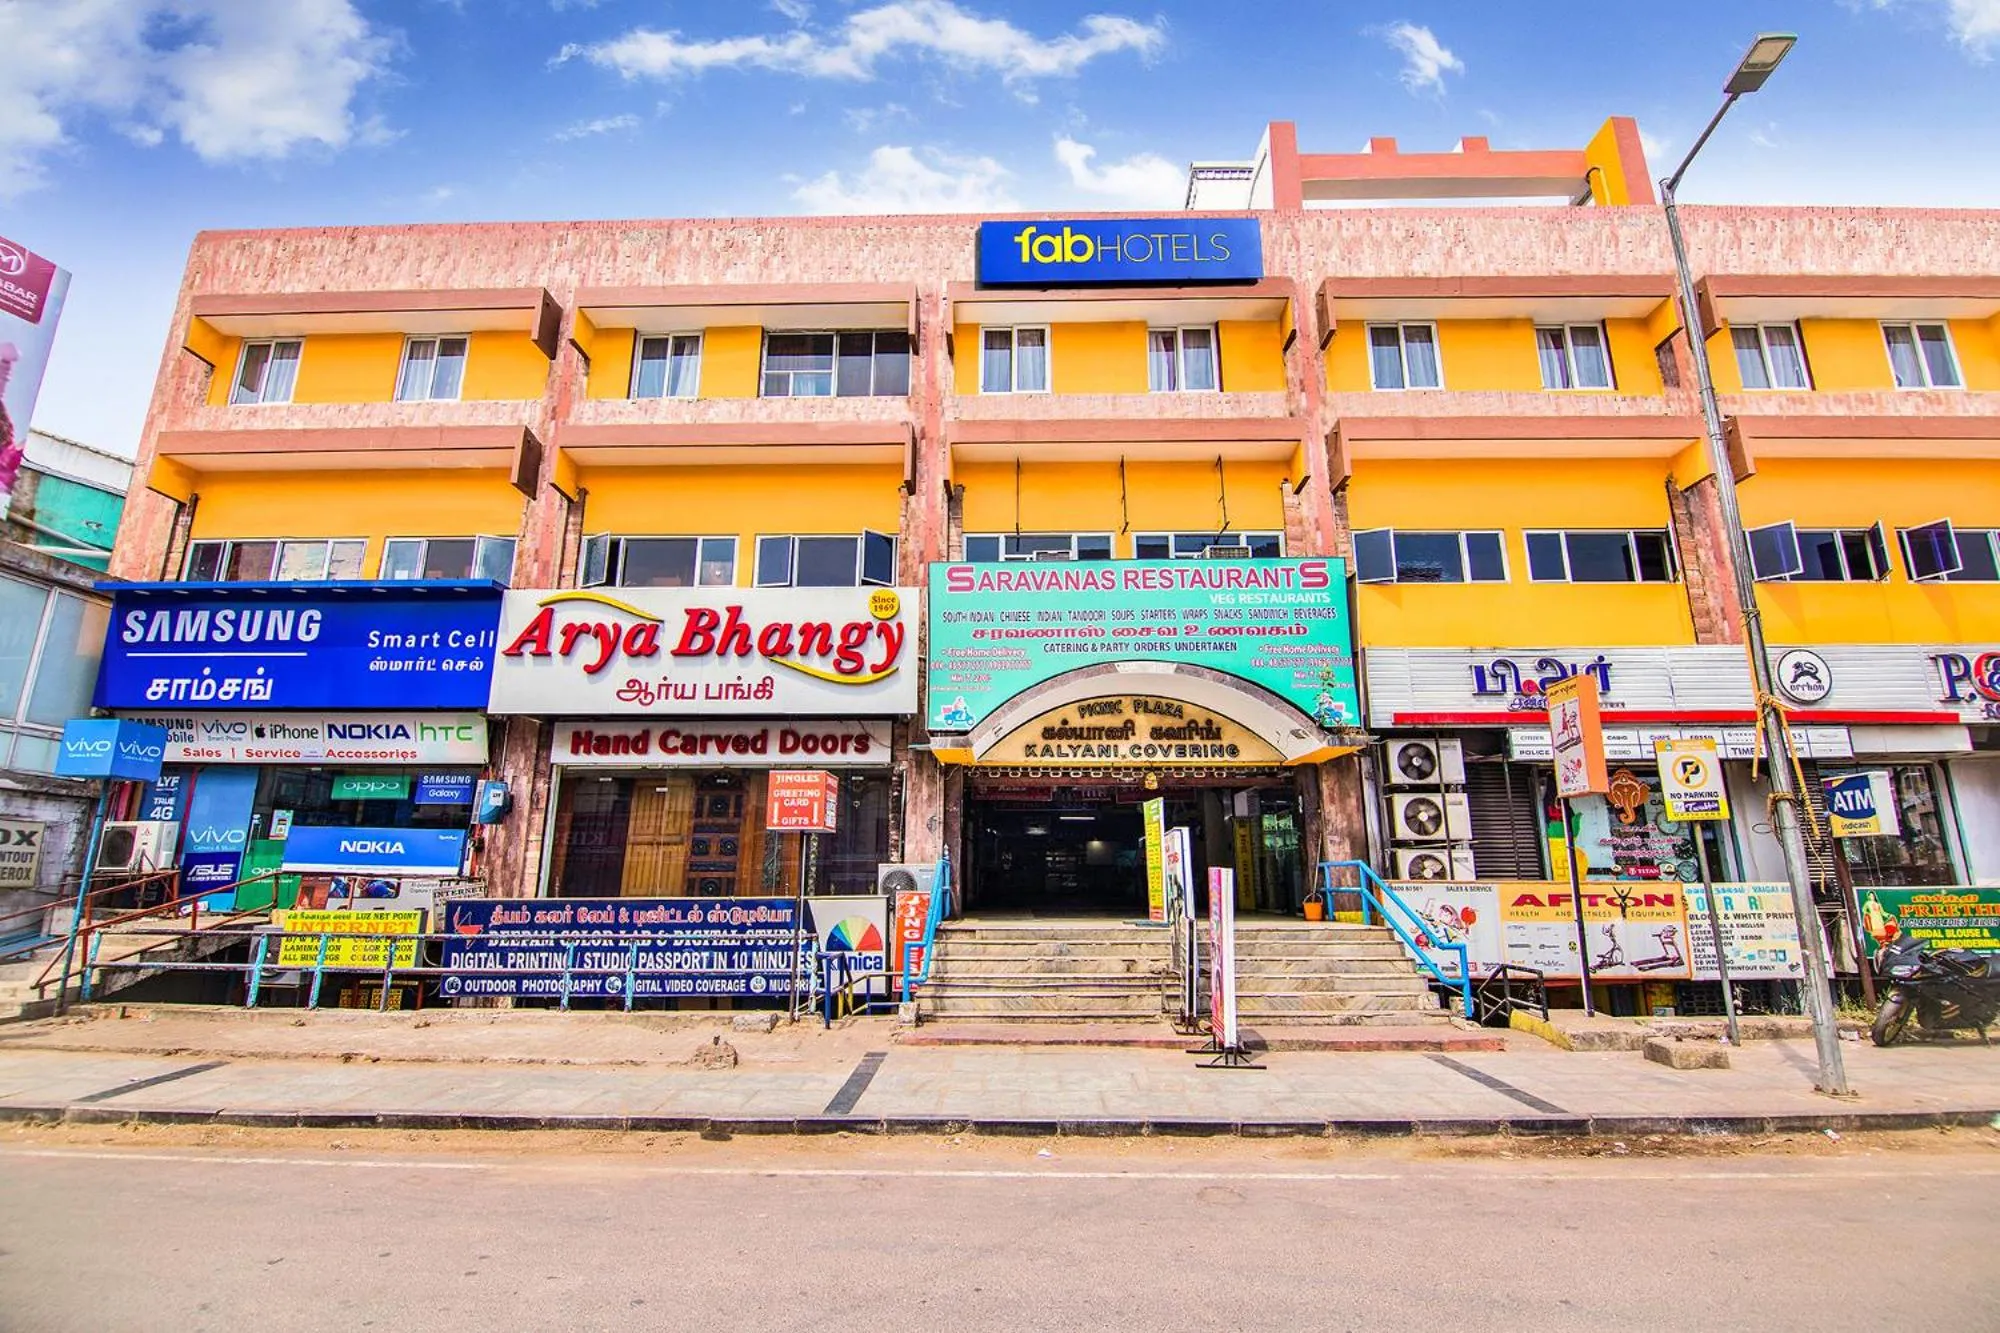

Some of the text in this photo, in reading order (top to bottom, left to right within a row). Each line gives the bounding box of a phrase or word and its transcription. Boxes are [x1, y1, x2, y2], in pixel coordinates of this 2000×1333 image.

[946, 561, 1330, 593] SARAVANAS RESTAURANTS
[871, 595, 896, 604] Since
[1209, 592, 1331, 605] VEG RESTAURANTS
[874, 604, 894, 612] 1969
[943, 608, 1337, 623] SOUTH INDIAN CHINESE INDIAN TANDOORI SOUPS STARTERS WRAPS SNACKS SANDWICH BEVERAGES
[122, 609, 322, 643] SAMSUNG
[368, 629, 494, 648] Smart Cell
[503, 606, 905, 674] Arya Bhangy
[1043, 641, 1237, 653] CATERING & PARTY ORDERS UNDERTAKEN
[369, 656, 484, 672] ஸ்மார்ட் செல்
[146, 666, 274, 702] சாம்சங்
[616, 675, 774, 706] ஆர்ய பங்கி
[1078, 699, 1185, 719] PICNIC PLAZA
[201, 719, 247, 734] vivo
[269, 724, 319, 740] iPhone
[327, 723, 410, 740] NOKIA
[420, 722, 473, 741] htc
[165, 731, 195, 743] obile
[571, 728, 870, 756] Hand Carved Doors
[65, 737, 112, 752] vivo
[120, 740, 161, 757] vivo
[1025, 743, 1240, 758] KALYANI COVERING
[183, 748, 222, 758] Sales
[245, 748, 300, 759] Service
[326, 747, 418, 761] Accessories
[343, 780, 400, 792] oppo
[422, 775, 471, 785] SAMSUNG
[775, 774, 820, 784] JINGLES
[428, 788, 461, 799] Galaxy
[773, 789, 820, 797] GREETING
[1670, 790, 1720, 800] NO PARKING
[1834, 788, 1875, 812] ATM
[150, 806, 173, 820] 4G
[781, 817, 809, 825] GIFTS
[190, 825, 245, 843] vivo
[340, 840, 405, 854] NOKIA
[188, 863, 236, 876] ASUS
[1511, 893, 1675, 907] AFTON
[373, 912, 390, 920] NET
[392, 912, 418, 920] POINT
[534, 904, 574, 924] கலர்
[618, 905, 630, 924] &
[1733, 912, 1764, 920] WHITE
[291, 921, 414, 933] INTERNET
[1911, 929, 1944, 938] BRIDAL
[1945, 929, 1981, 938] BLOUSE
[487, 929, 555, 947] DEEPAM
[559, 929, 615, 947] COLOR
[672, 929, 741, 946] DIGITAL
[383, 944, 413, 952] XROX
[450, 952, 503, 969] DIGITAL
[639, 951, 709, 969] PASSPORT
[712, 951, 727, 969] IN
[732, 951, 748, 969] 10
[464, 979, 517, 992] OUTDOOR
[664, 979, 693, 992] VIDEO
[695, 979, 746, 992] COVERAGE
[769, 979, 791, 992] MUG
